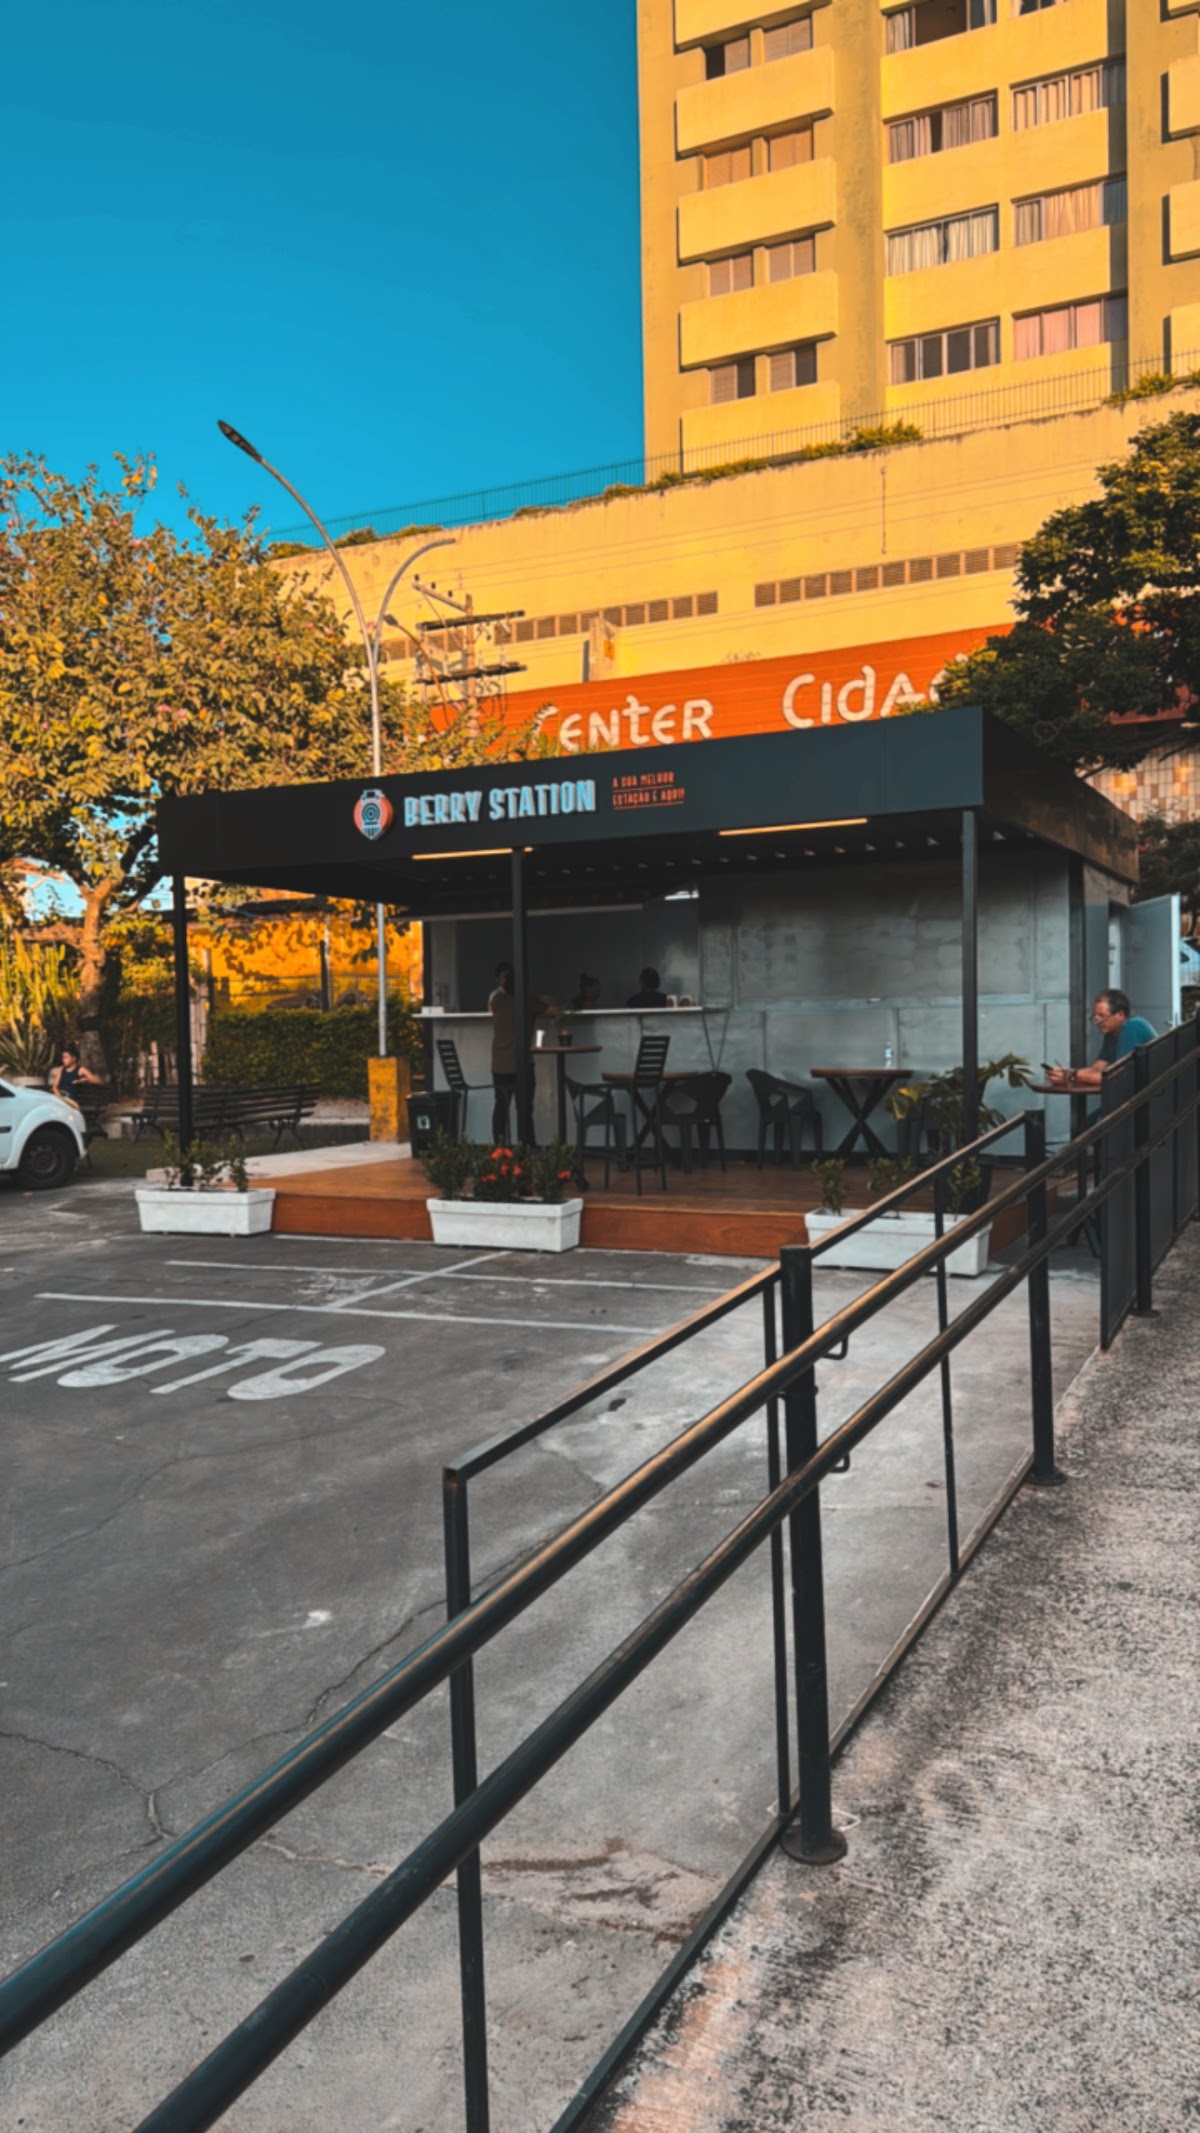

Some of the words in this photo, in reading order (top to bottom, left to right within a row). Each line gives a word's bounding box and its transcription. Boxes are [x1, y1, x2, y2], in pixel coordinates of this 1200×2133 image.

[404, 790, 482, 828] BERRY
[489, 779, 596, 821] STATION
[0, 1324, 386, 1400] MOTO
